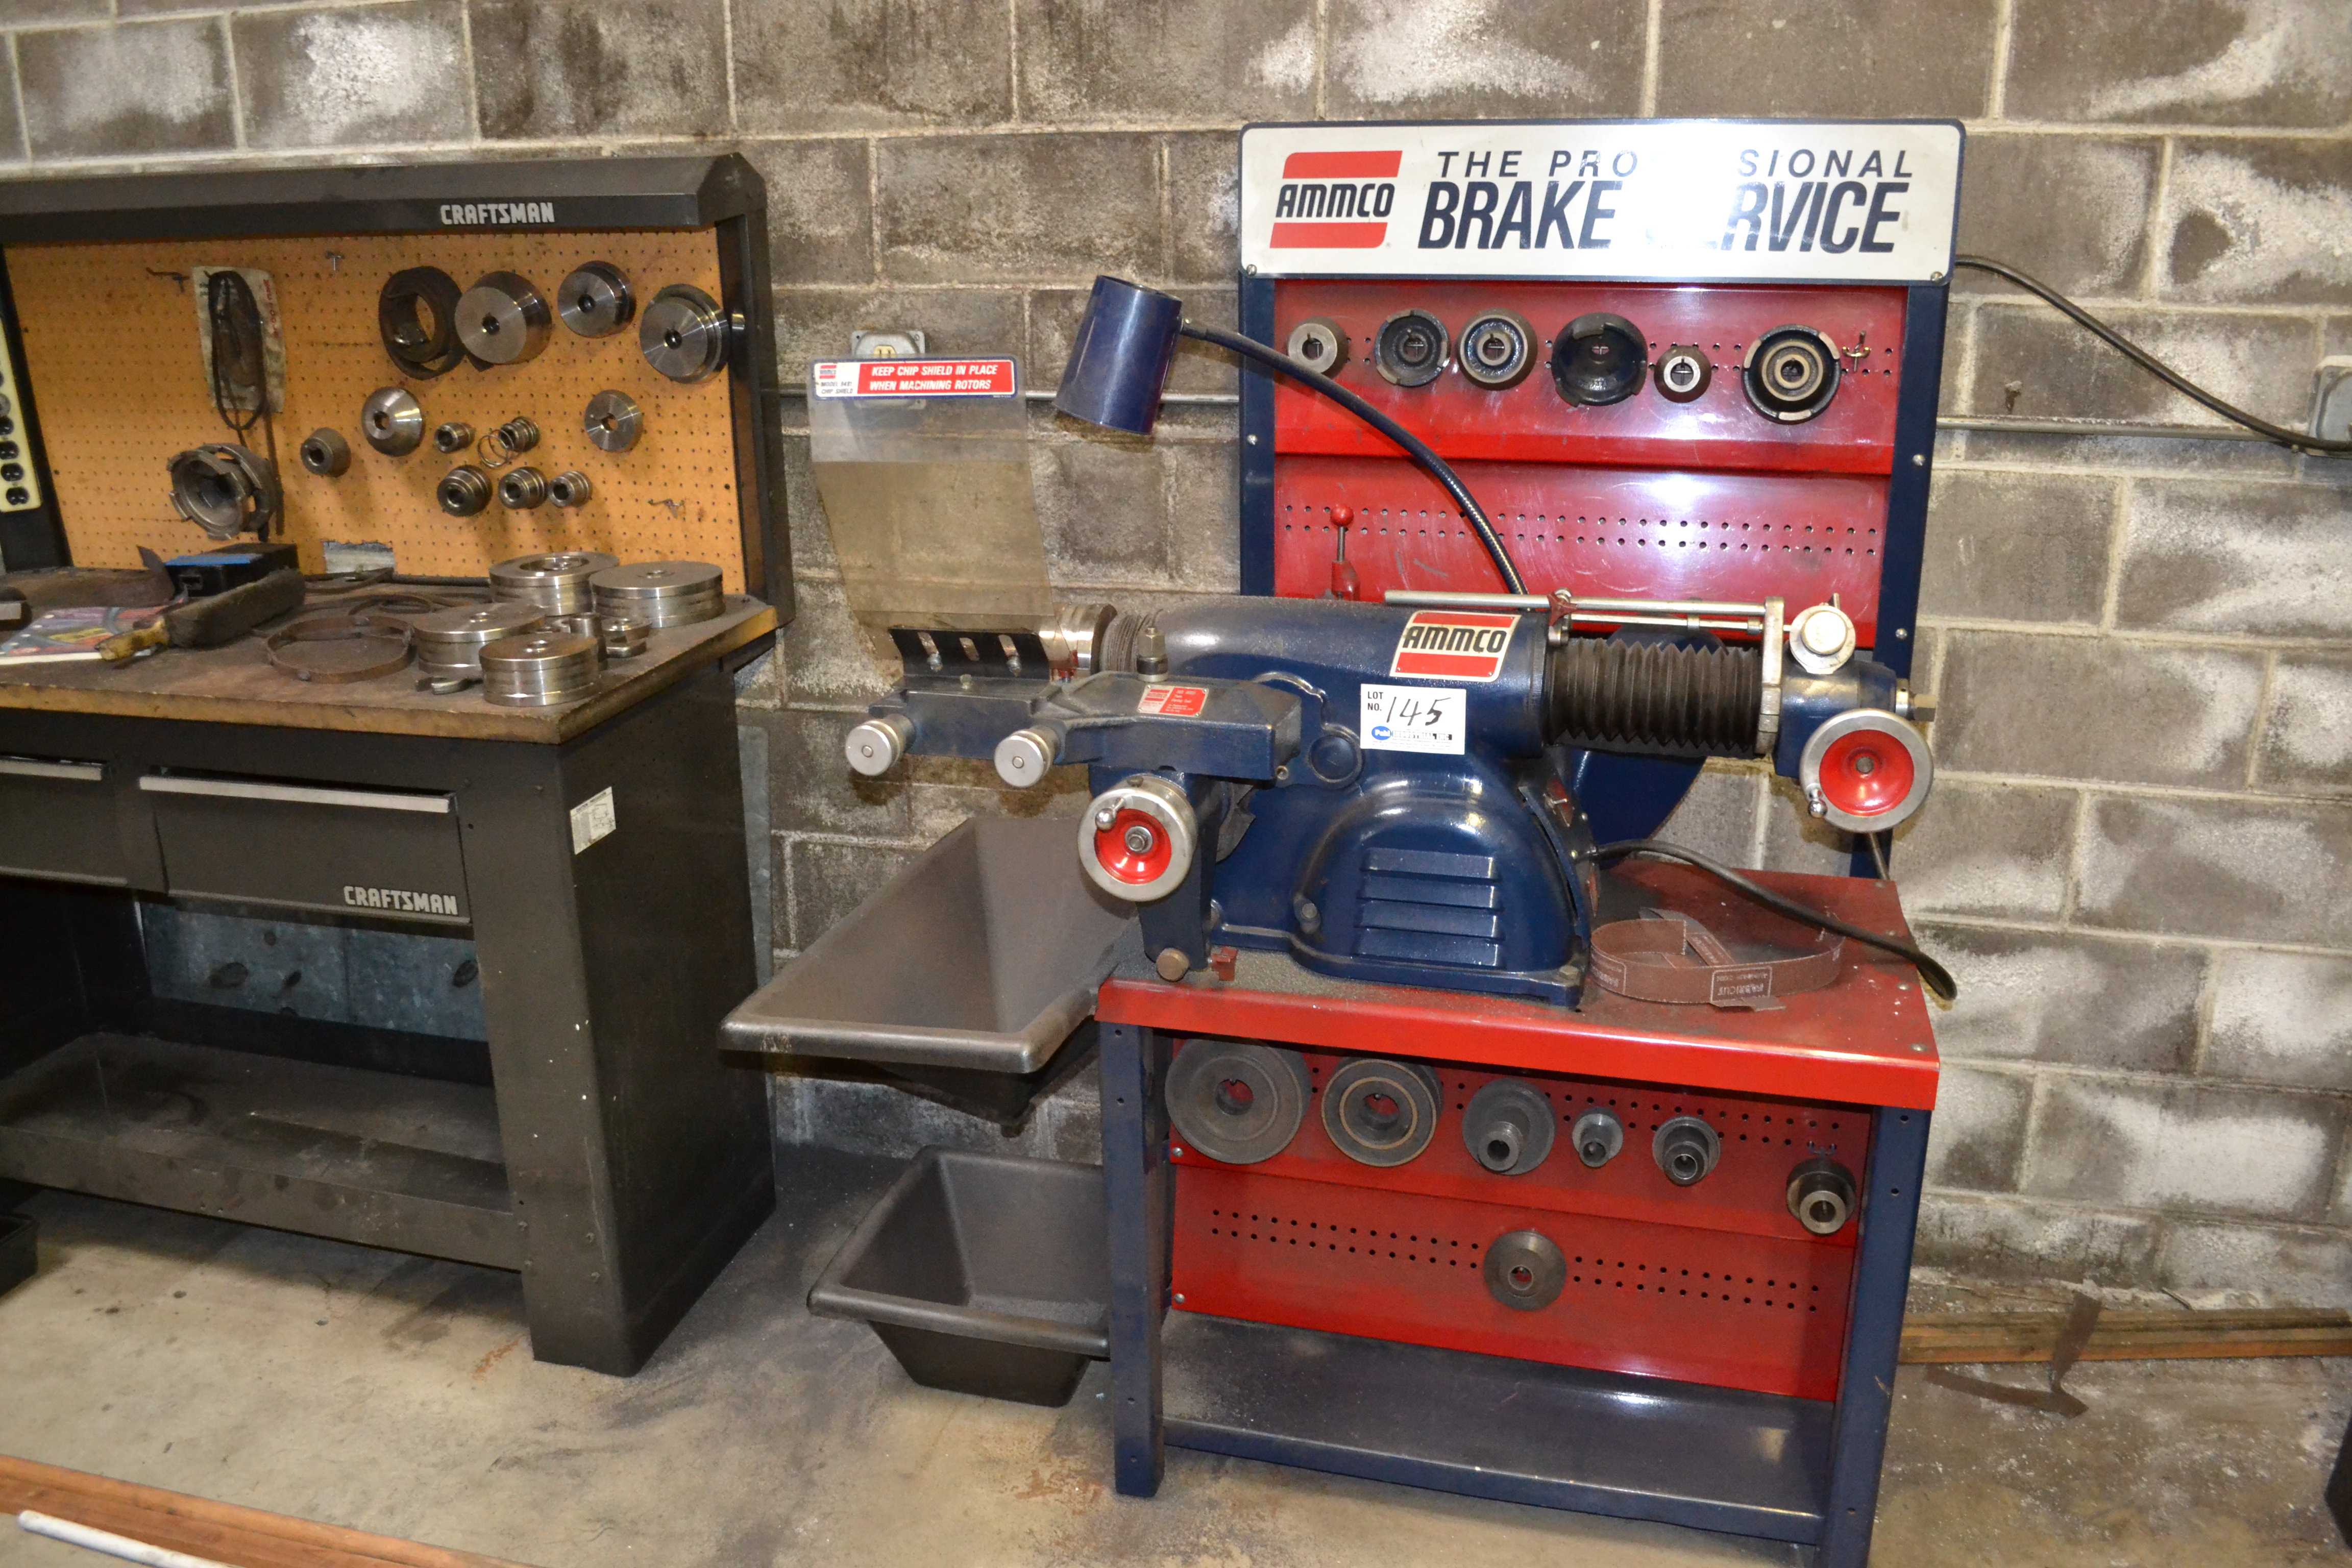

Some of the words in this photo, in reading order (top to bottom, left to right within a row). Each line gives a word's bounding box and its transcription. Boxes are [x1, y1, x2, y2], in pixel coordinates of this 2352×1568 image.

[1437, 151, 1522, 178] THE
[1549, 149, 1913, 178] PROSIONAL
[440, 202, 555, 225] CRAFTSMAN
[1276, 183, 1395, 218] AMMCO
[1418, 181, 1623, 249] BRAKE
[1642, 181, 1909, 254] RVICE
[872, 366, 895, 376] KEEP
[897, 365, 919, 376] CHIP
[921, 365, 953, 376] SHIELD
[955, 365, 967, 375] IN
[969, 364, 998, 375] PLACE
[870, 381, 897, 390] WHEN
[899, 380, 952, 390] MACHINING
[954, 380, 992, 389] ROTORS
[1402, 626, 1507, 653] AMMCO
[1368, 691, 1384, 700] LOT
[1368, 703, 1382, 711] NO.
[1386, 696, 1451, 726] 145
[343, 886, 458, 915] CRAFTSMAN
